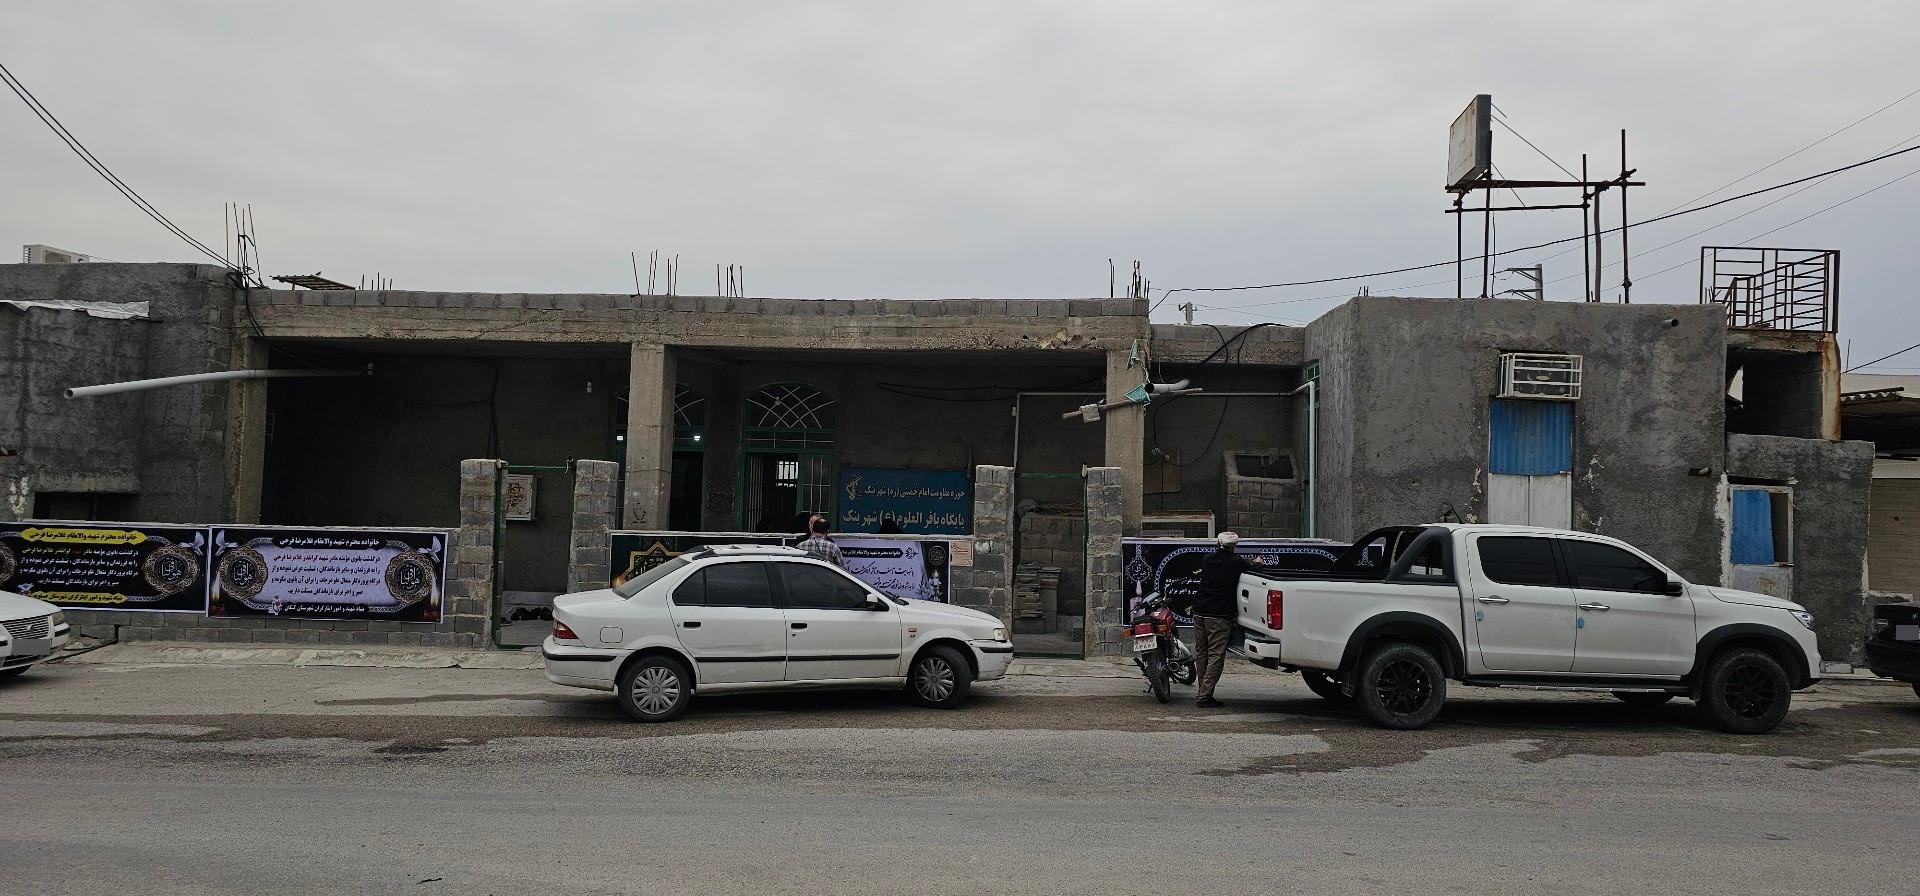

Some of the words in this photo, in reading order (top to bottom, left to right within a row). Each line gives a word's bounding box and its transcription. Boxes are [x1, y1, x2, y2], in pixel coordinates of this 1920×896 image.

[876, 486, 886, 497] شهر
[888, 486, 900, 498] (ره)
[900, 488, 918, 498] خمینی
[919, 488, 930, 498] امام
[931, 488, 950, 500] مقاومت
[950, 490, 965, 500] حوزه
[860, 510, 878, 526] شهر
[923, 510, 940, 528] باقر
[940, 513, 964, 529] پایگاه
[295, 537, 313, 545] غلامرضا
[313, 538, 332, 546] والامقام
[361, 538, 380, 546] خانواده
